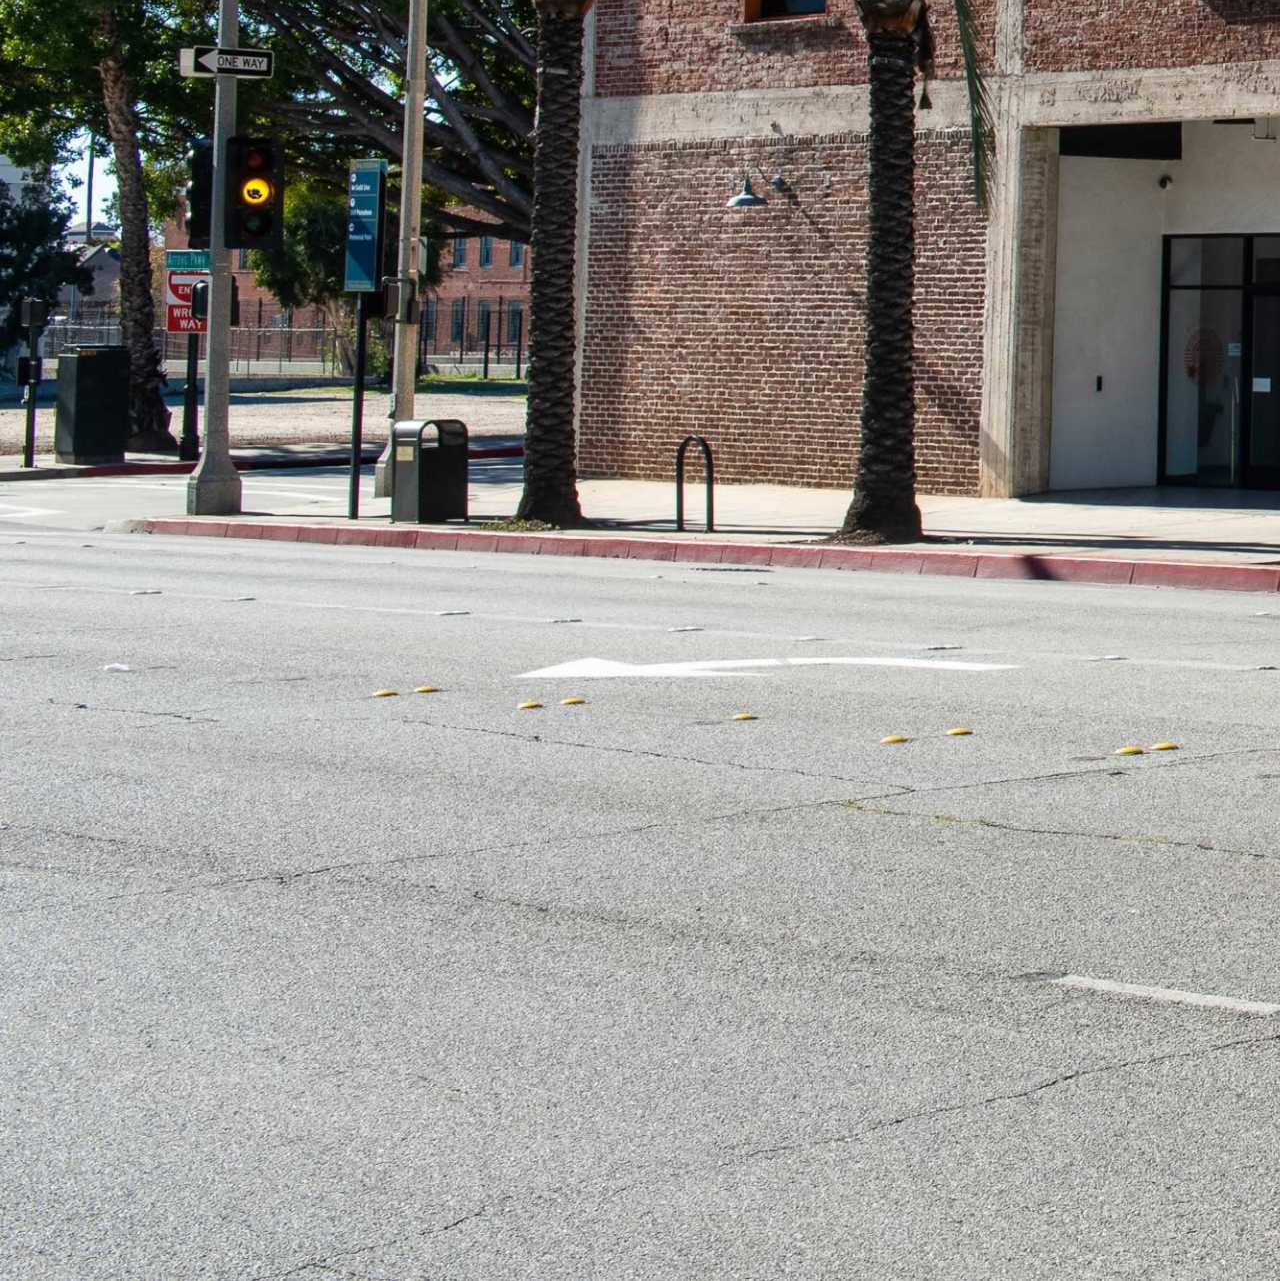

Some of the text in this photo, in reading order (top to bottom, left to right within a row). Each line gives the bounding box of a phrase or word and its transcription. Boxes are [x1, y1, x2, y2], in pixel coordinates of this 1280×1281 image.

[217, 55, 264, 69] ONE WAY
[180, 319, 202, 329] WAY
